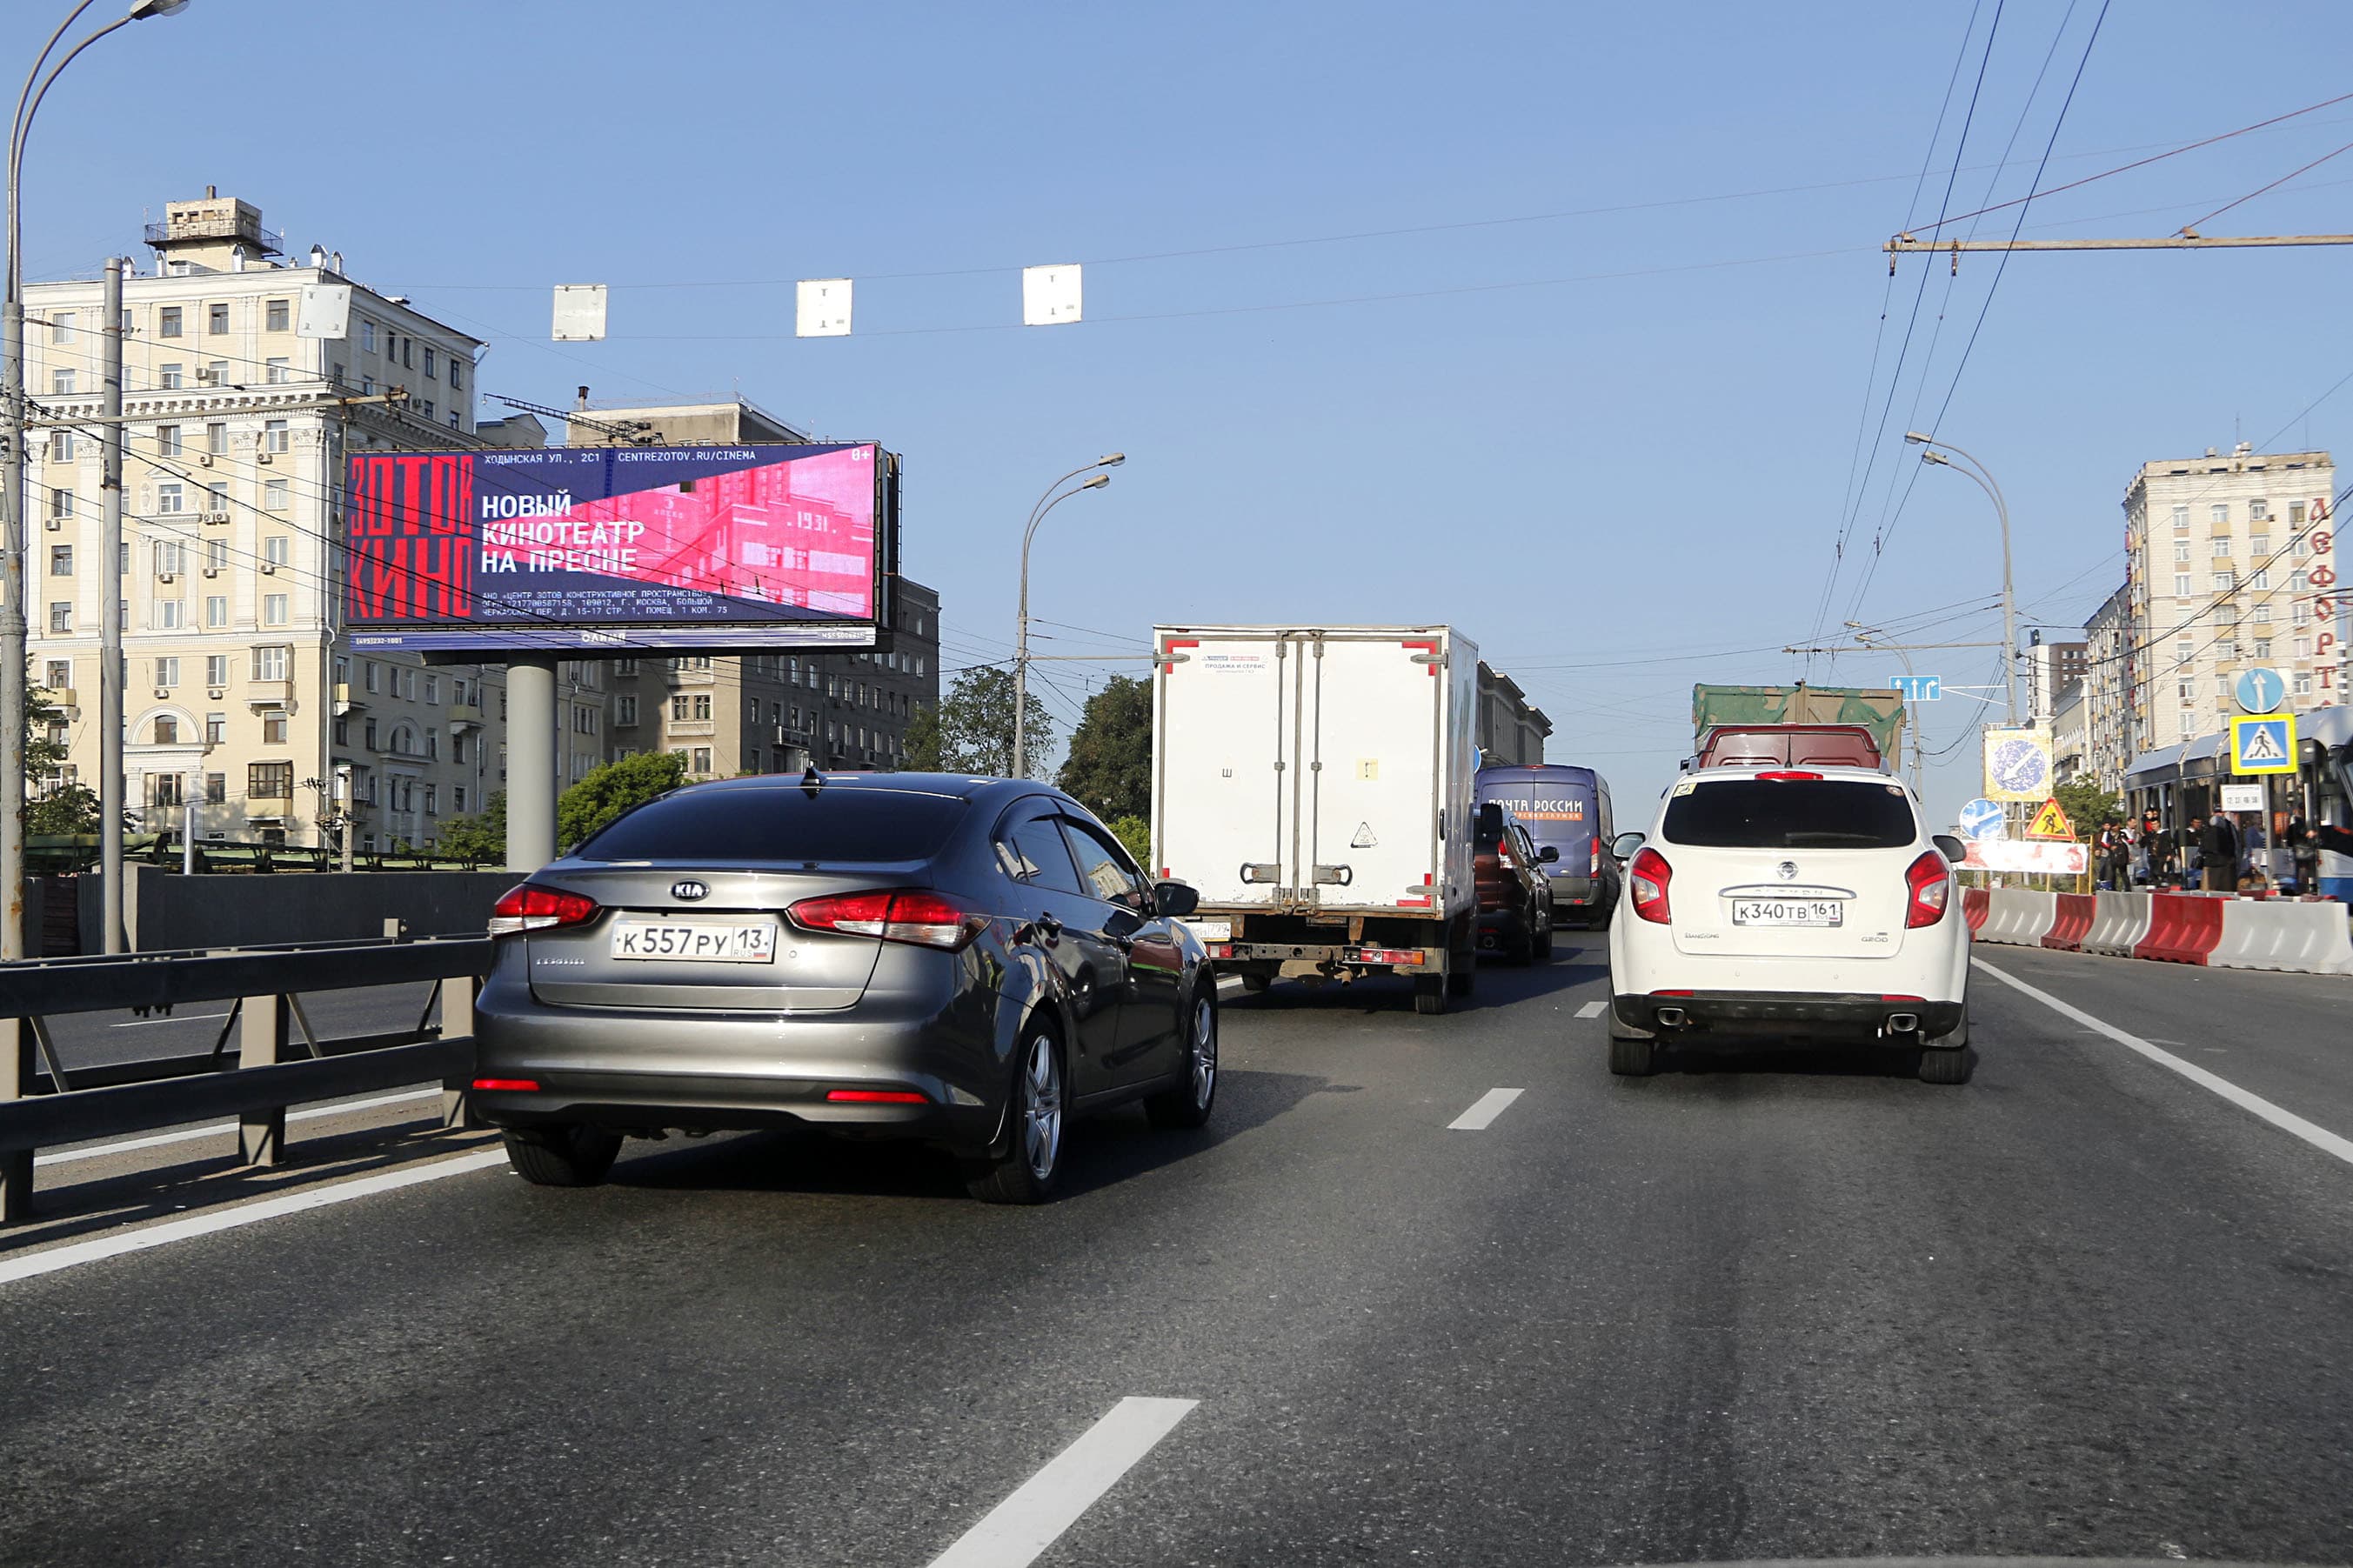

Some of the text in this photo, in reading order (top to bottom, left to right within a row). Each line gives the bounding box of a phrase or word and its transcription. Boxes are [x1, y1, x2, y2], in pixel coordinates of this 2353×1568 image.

[484, 454, 543, 465] ХОДЫНСКАЯ
[618, 450, 756, 462] CENTREZOTOV.RU/CINEMA
[852, 448, 870, 461] 0+
[351, 455, 474, 537] ЗОТОВ
[482, 489, 572, 517] НОВЫЙ
[483, 521, 645, 546] КИНОТЕАТР
[481, 549, 637, 573] НА ПРЕСНЕ
[350, 537, 472, 619] КИНО
[1534, 800, 1582, 812] РОССИИ
[675, 884, 703, 897] KIA
[1810, 903, 1836, 916] 161
[738, 929, 762, 949] 13
